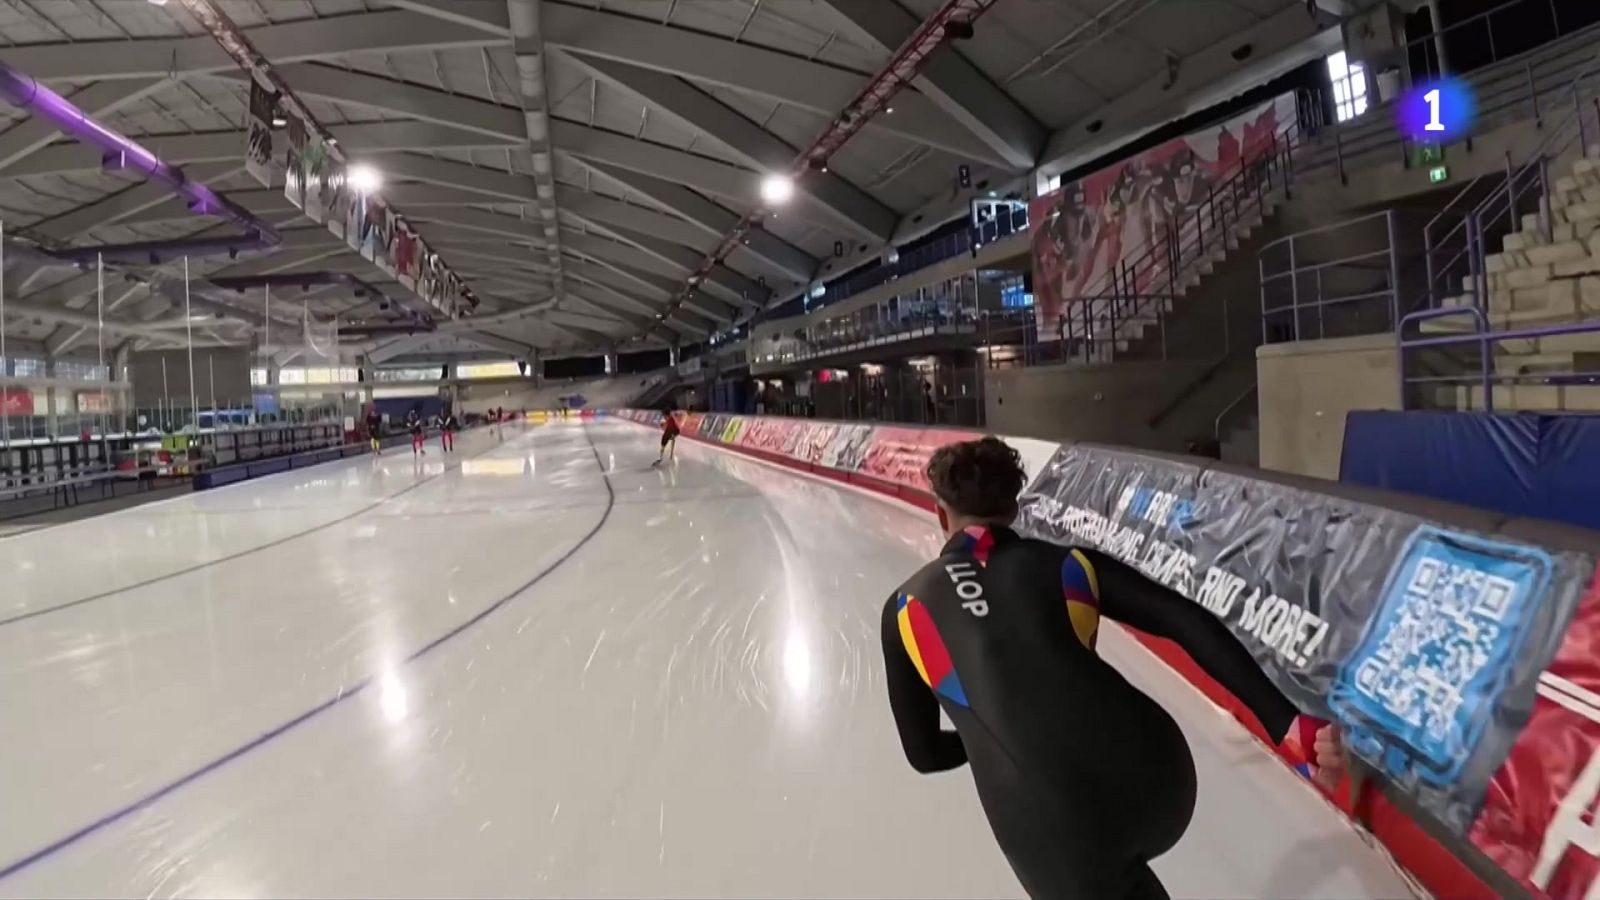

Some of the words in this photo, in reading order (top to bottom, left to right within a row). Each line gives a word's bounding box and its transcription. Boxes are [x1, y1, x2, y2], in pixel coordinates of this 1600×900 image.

[944, 562, 989, 617] LLOP
[1196, 566, 1246, 618] AND
[1238, 586, 1329, 668] MORE!
